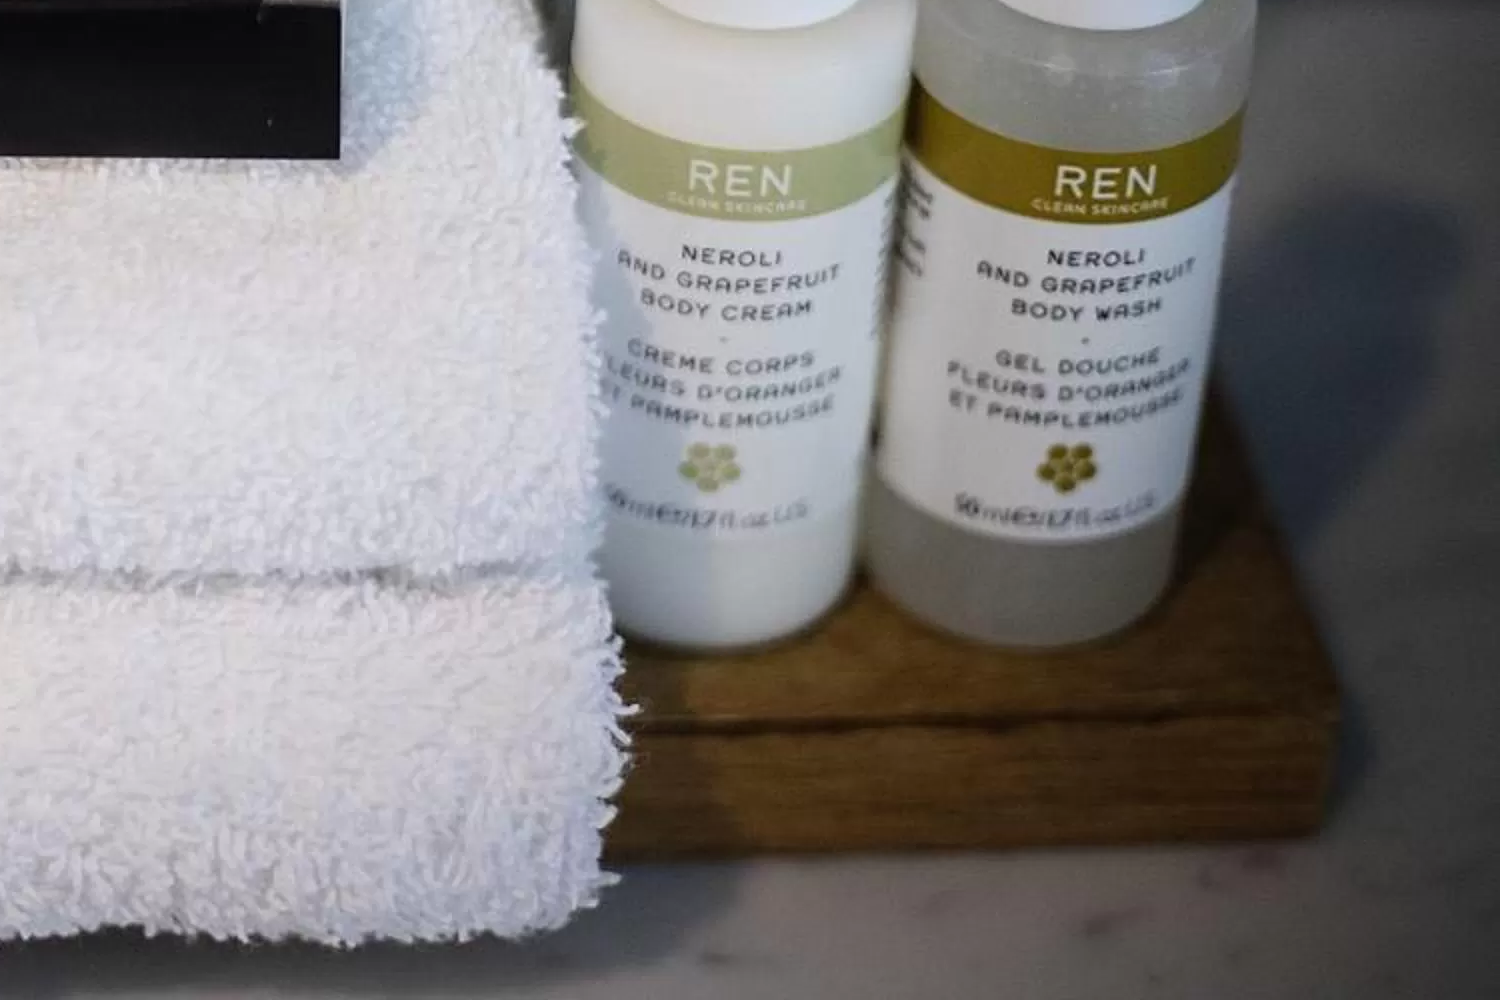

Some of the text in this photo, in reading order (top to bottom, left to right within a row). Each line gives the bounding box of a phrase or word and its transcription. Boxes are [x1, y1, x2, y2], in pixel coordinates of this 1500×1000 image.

[689, 159, 793, 197] REN
[1054, 165, 1157, 199] REN
[1032, 198, 1169, 216] CLEAN SKINCARE
[618, 249, 841, 295] AND GRAPEFRUIT
[682, 245, 782, 267] NEROLI
[1047, 249, 1146, 267] NEROLI
[978, 257, 1196, 294] AND GRAPEFRUIT
[641, 288, 812, 322] BODY CREAM
[1012, 299, 1162, 321] BODY WASH
[726, 350, 815, 375] CORPS
[996, 347, 1161, 376] GEL DOUCHE
[698, 365, 841, 401] D'ORANGER
[947, 357, 1190, 402] FLEURS D'ORANGER
[631, 393, 834, 428] PAMPLEMOUSSE
[949, 388, 1182, 428] ET PAMPLEMOUSSE
